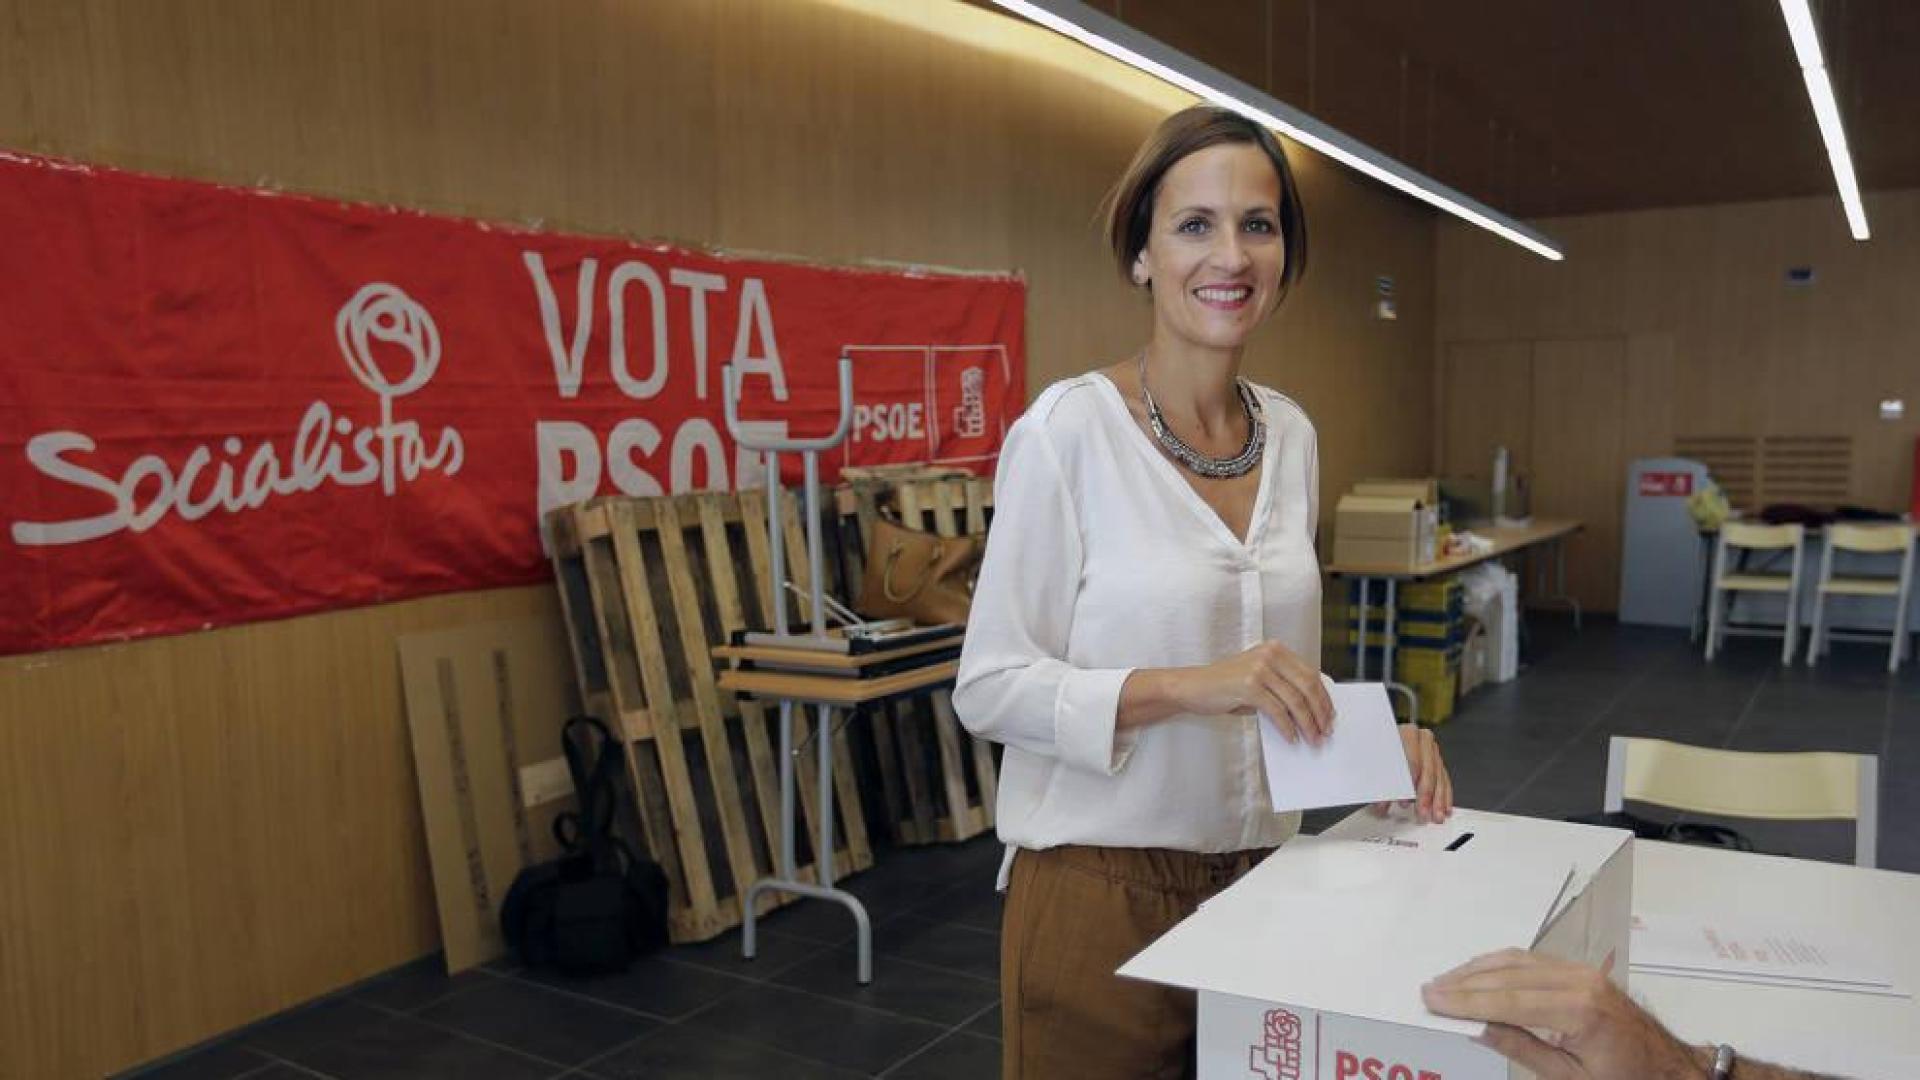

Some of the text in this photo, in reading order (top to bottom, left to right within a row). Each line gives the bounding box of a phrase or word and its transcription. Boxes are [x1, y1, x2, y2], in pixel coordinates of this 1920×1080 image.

[522, 251, 789, 400] VOTA
[11, 400, 465, 546] Socialistas
[852, 402, 926, 443] PSOE
